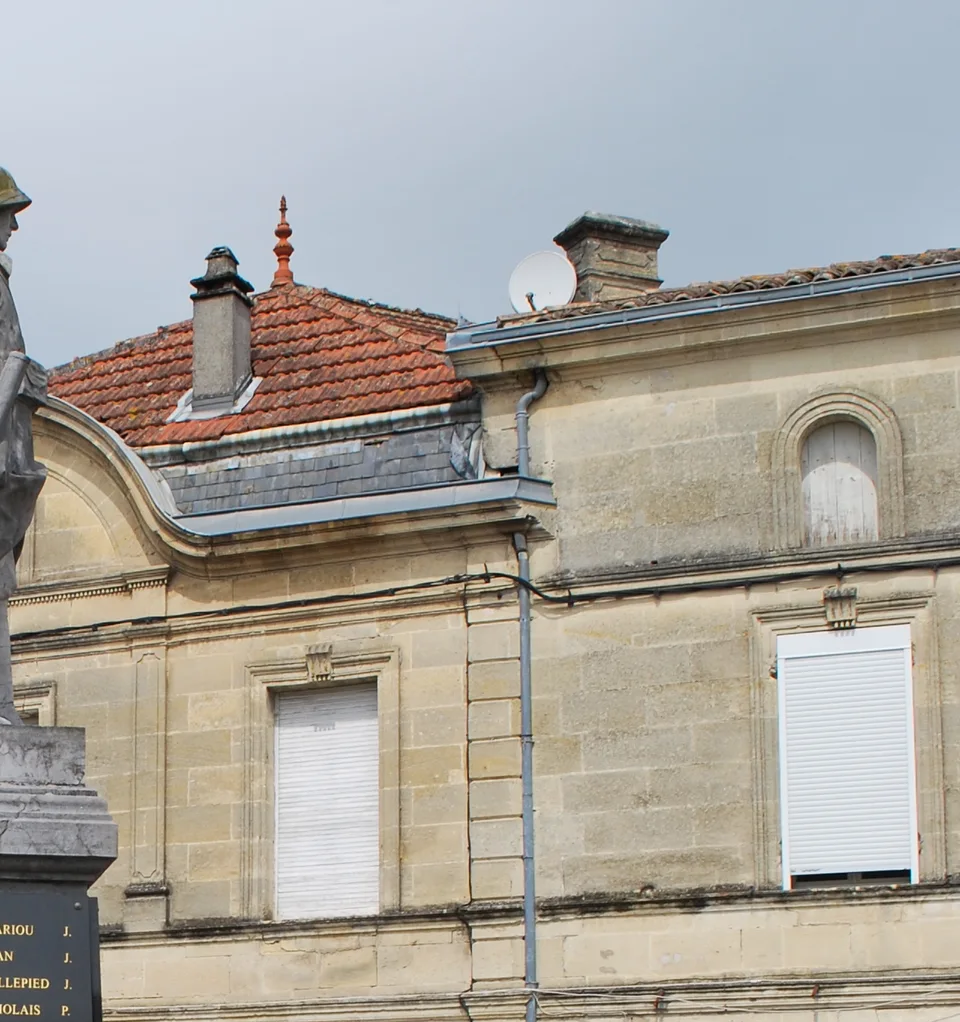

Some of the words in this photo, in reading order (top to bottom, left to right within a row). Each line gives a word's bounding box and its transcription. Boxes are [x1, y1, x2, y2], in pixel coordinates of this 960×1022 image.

[63, 925, 72, 938] J.
[64, 952, 72, 965] J.
[64, 979, 72, 991] J.
[61, 1005, 70, 1017] P.
